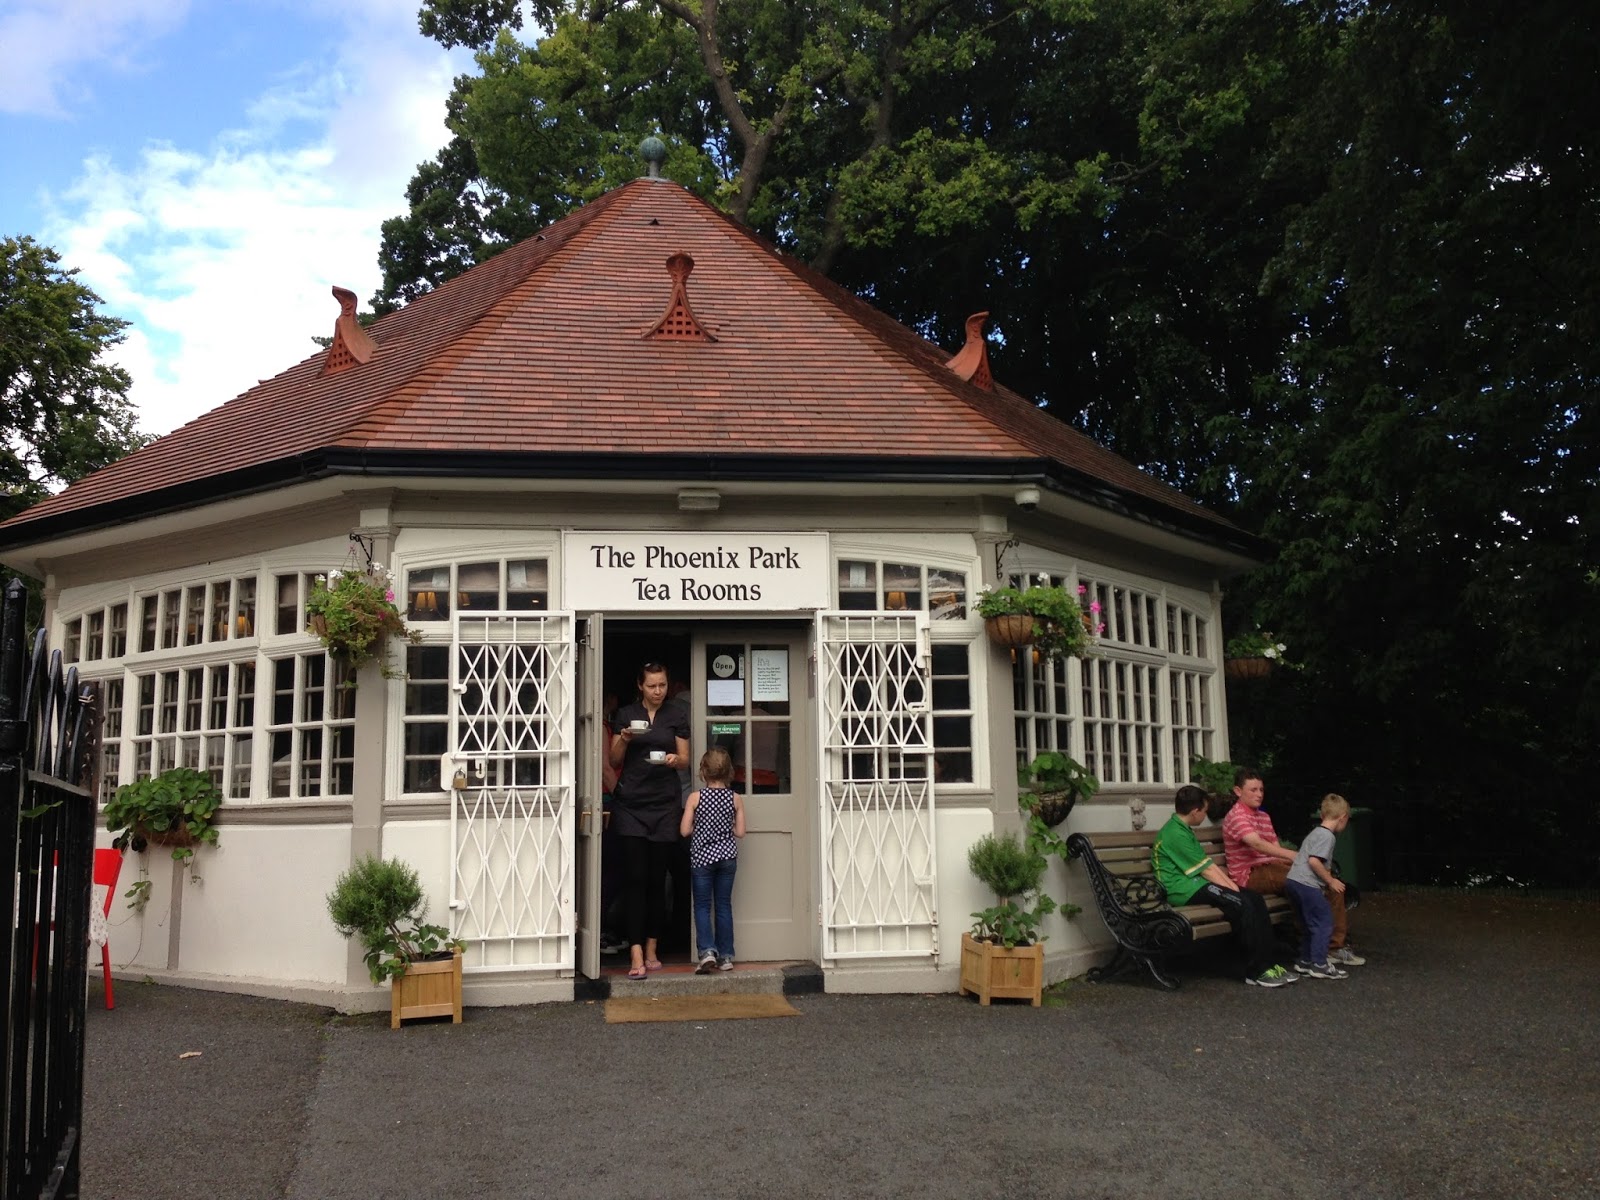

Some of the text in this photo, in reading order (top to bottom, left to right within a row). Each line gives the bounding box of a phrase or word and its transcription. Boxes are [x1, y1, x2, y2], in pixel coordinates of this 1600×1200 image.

[591, 545, 801, 569] The Phoenix Park
[632, 577, 761, 601] Tea Rooms
[715, 662, 733, 670] Open
